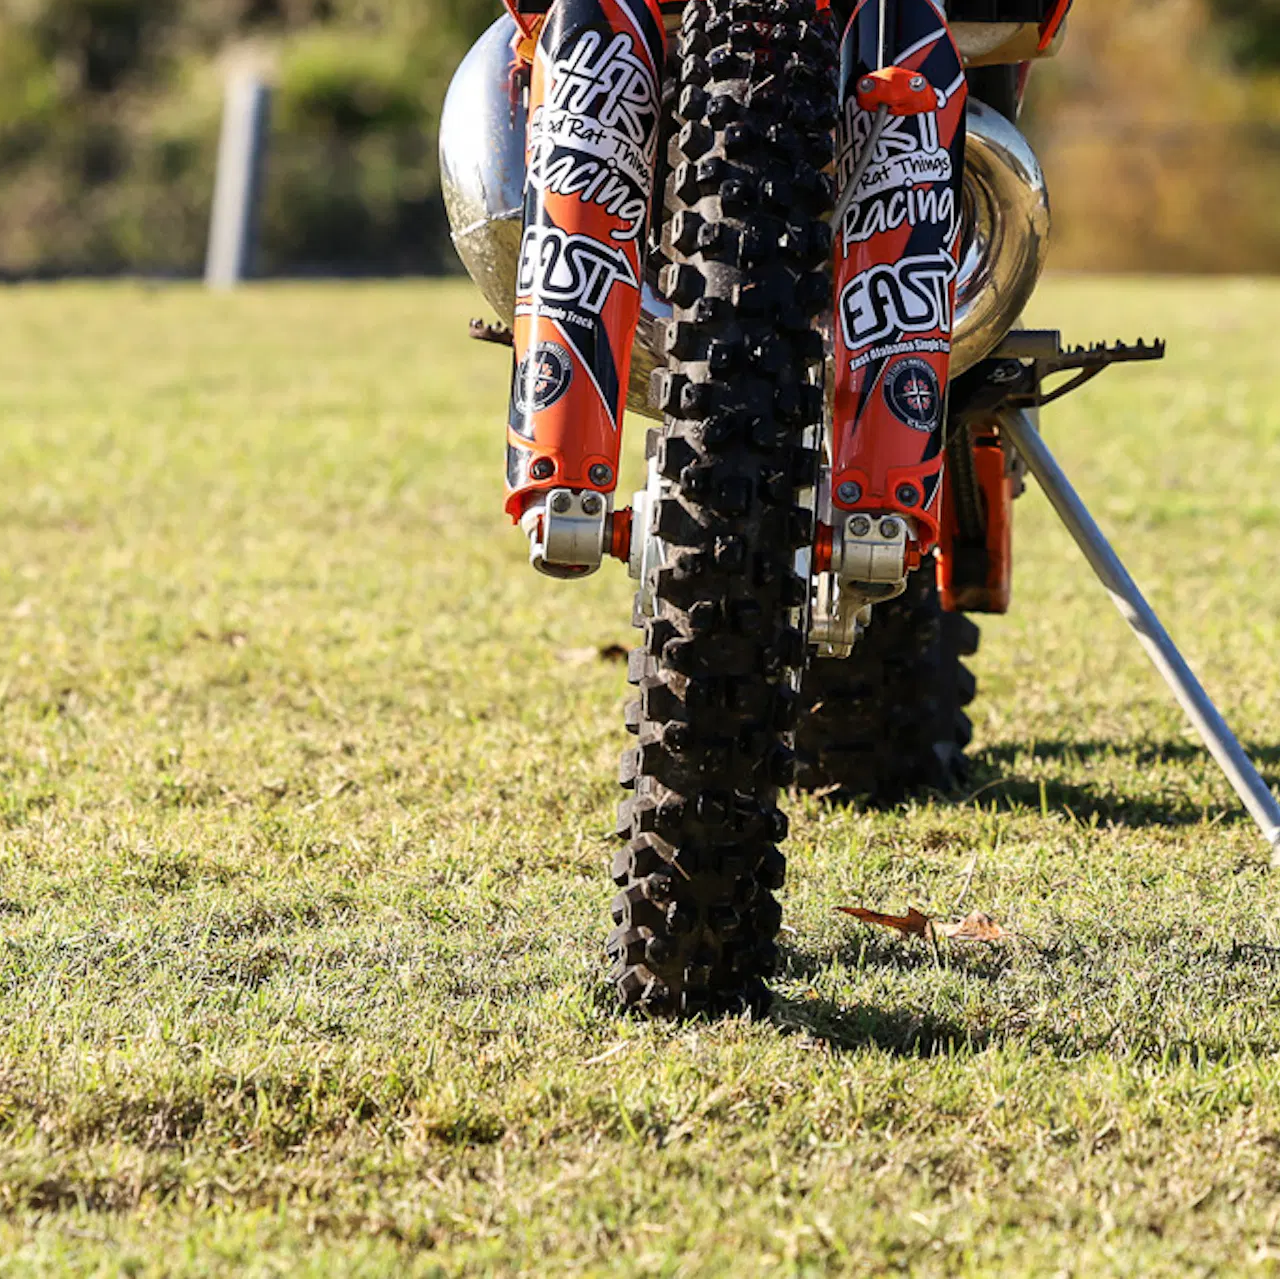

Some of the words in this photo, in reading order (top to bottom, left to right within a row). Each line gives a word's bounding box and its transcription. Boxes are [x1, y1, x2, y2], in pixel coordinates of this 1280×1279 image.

[523, 136, 647, 241] Racing
[894, 155, 950, 179] Things
[841, 177, 956, 260] Racing
[839, 247, 958, 351] EAST
